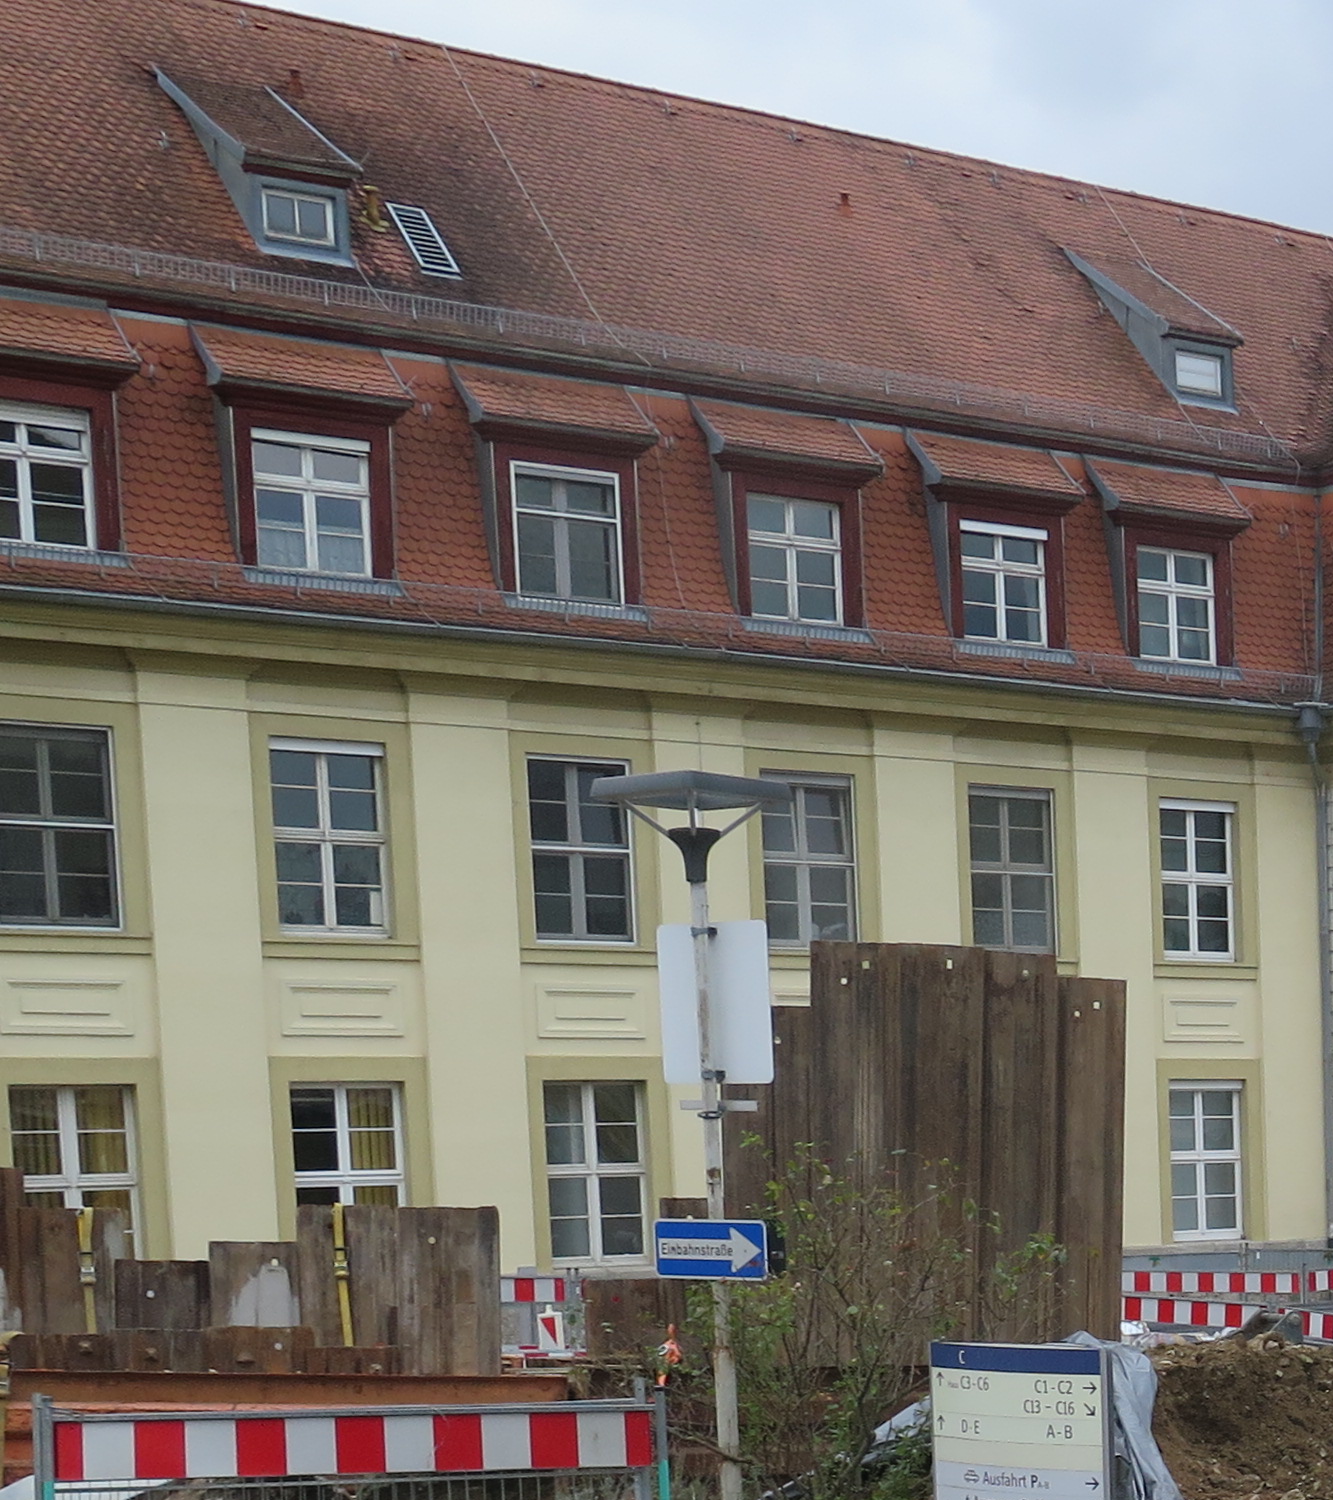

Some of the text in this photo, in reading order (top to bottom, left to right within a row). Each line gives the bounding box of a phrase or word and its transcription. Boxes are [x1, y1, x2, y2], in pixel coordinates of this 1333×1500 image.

[661, 1242, 733, 1256] Einbahnstraße
[959, 1350, 966, 1364] C
[983, 1471, 1028, 1489] Ausfahrt
